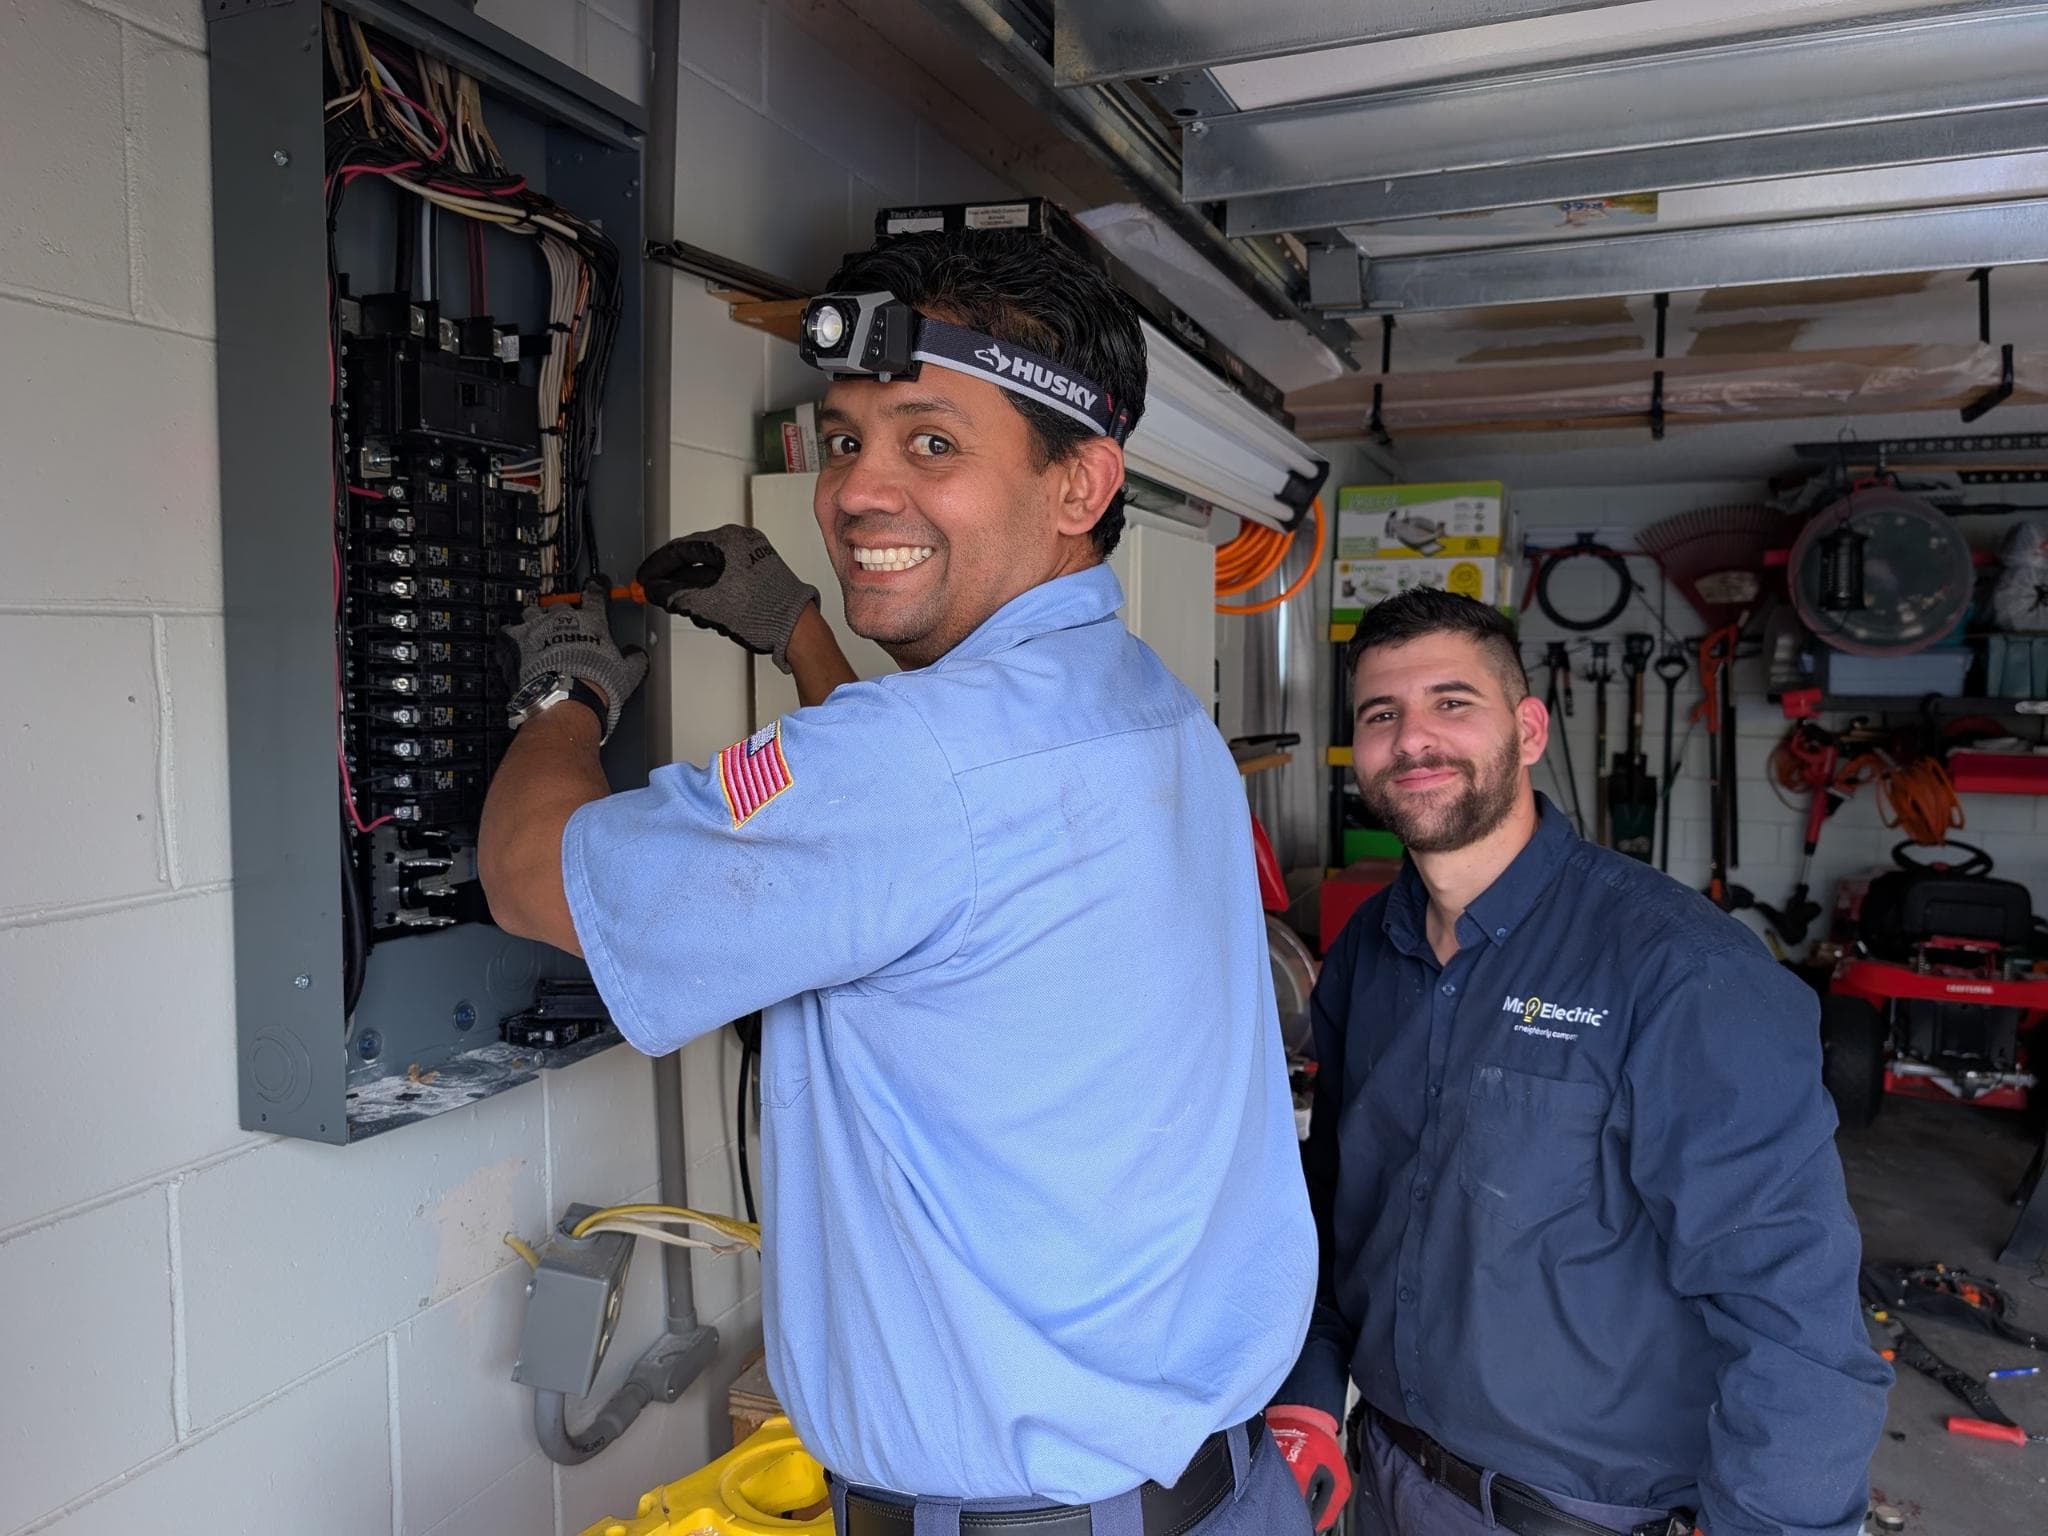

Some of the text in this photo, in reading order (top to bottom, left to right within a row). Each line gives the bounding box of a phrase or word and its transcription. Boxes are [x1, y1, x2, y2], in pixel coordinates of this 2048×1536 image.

[908, 208, 943, 218] Collection
[1010, 356, 1098, 412] HUSKY
[543, 632, 600, 650] HARDY
[1502, 996, 1525, 1014] Mr.
